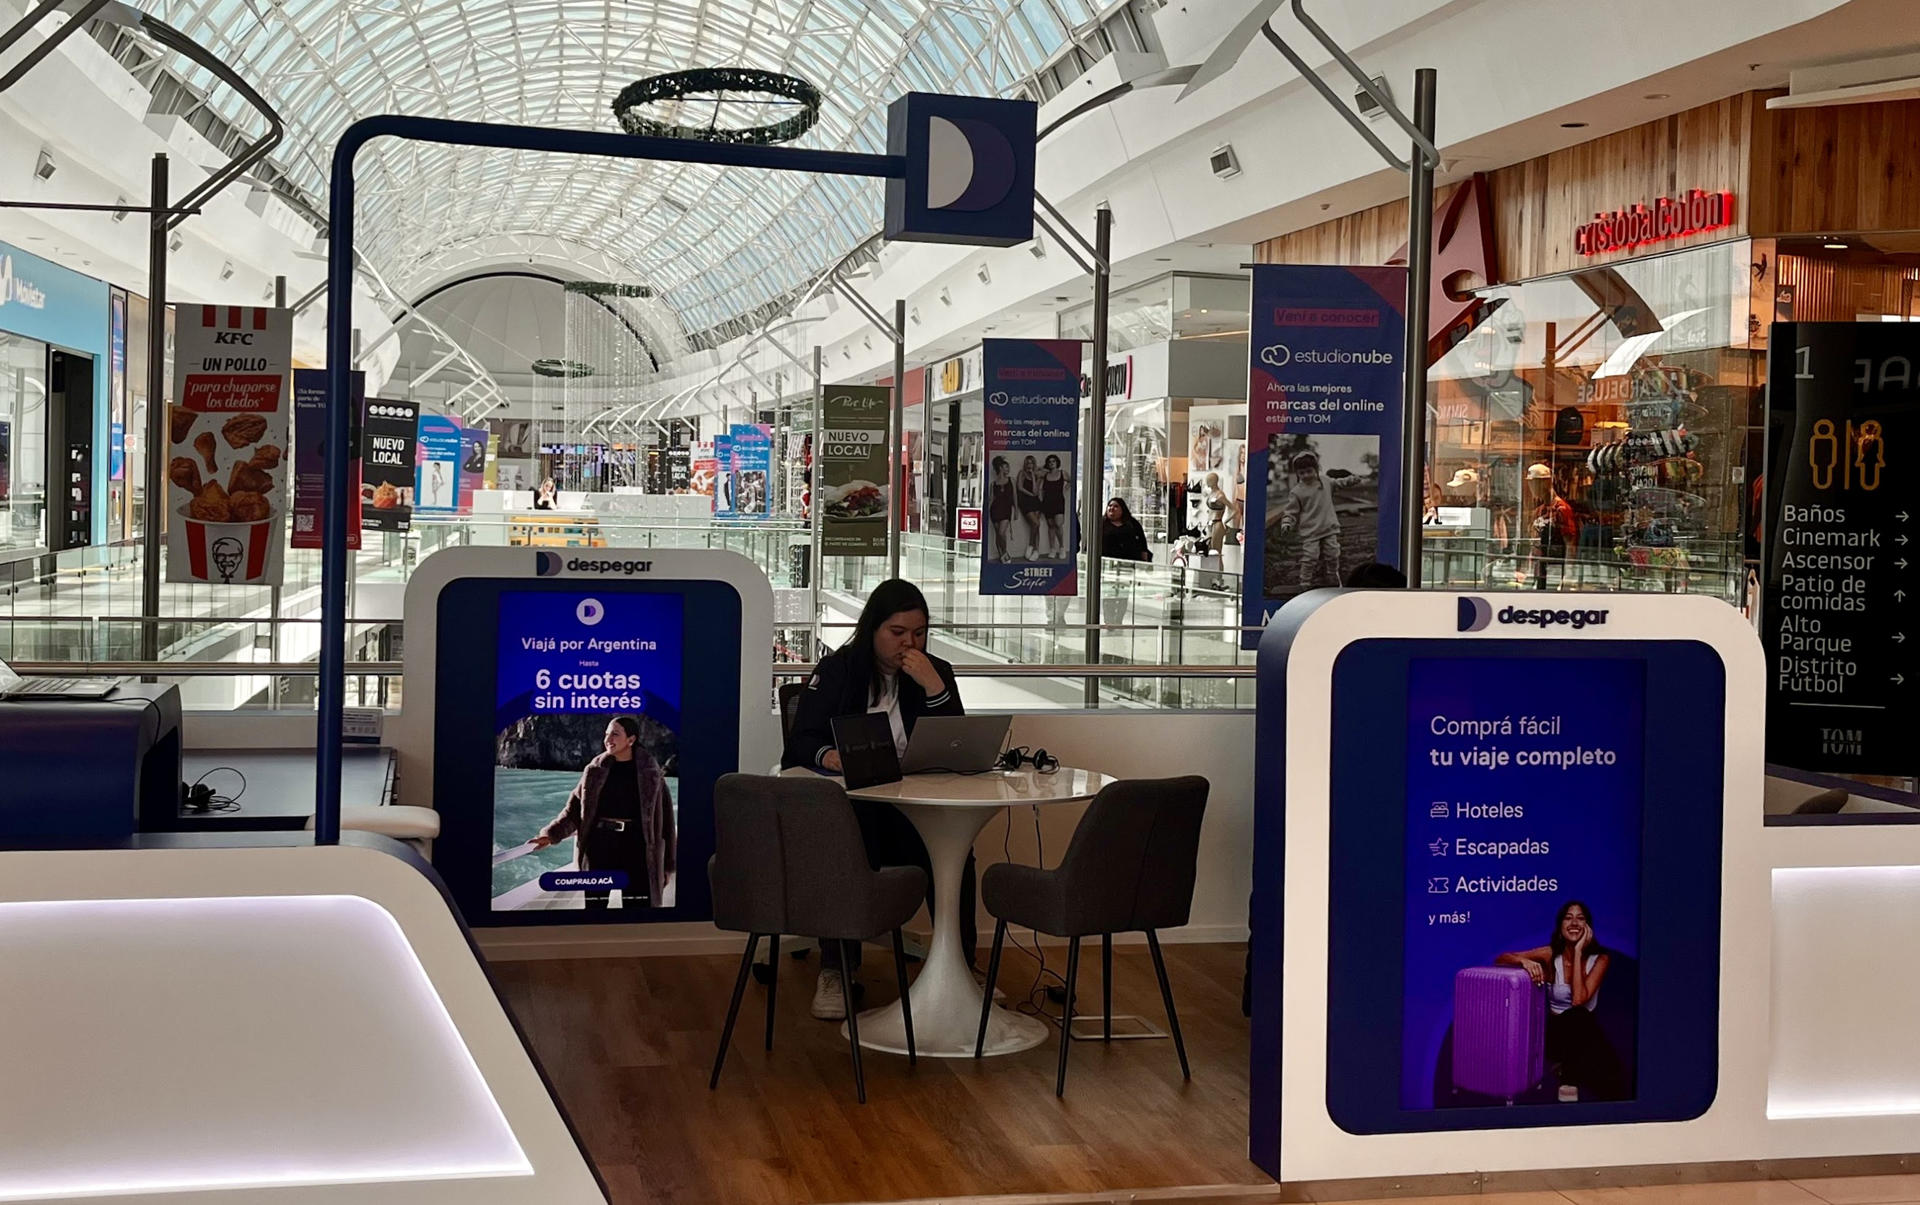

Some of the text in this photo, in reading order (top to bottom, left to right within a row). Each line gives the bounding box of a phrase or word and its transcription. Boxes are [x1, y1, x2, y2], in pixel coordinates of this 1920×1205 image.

[215, 332, 254, 346] KFC
[202, 357, 267, 374] UN POLLO
[1294, 349, 1393, 364] estudionube
[1794, 346, 1815, 379] 1
[222, 377, 277, 397] chuparse
[1265, 382, 1352, 396] Ahora las mejores
[206, 392, 221, 408] los
[1011, 394, 1075, 405] estudionube
[1266, 399, 1385, 412] marcas del online
[1265, 414, 1331, 424] están en TOM
[828, 431, 870, 442] NUEVO
[993, 428, 1071, 439] marcas del online
[372, 437, 405, 451] NUEVO
[828, 444, 869, 456] LOCAL
[372, 450, 403, 465] LOCAL
[1783, 504, 1846, 523] Baños
[1782, 528, 1881, 547] Cinemark
[566, 558, 653, 575] despegar
[1781, 552, 1875, 570] Ascensor
[1004, 571, 1047, 591] Style
[1024, 567, 1054, 577] STREET
[1781, 573, 1866, 594] Patio de
[1780, 592, 1866, 612] comidas
[1497, 605, 1609, 629] despegar
[1780, 615, 1822, 633] Alto
[521, 637, 658, 654] Viajá por Argentina
[1780, 633, 1852, 656] Parque
[578, 659, 600, 668] Hasta
[1779, 656, 1858, 676] Distrito
[535, 668, 642, 690] 6 cuotas
[1779, 672, 1844, 694] Fútbol
[534, 691, 642, 709] sin interés
[1430, 715, 1562, 740] Comprá fácil
[1429, 746, 1617, 770] tu viaje completo
[1456, 801, 1524, 819] Hoteles
[1455, 837, 1550, 859] Escapadas
[554, 877, 597, 886] COMPRALO
[1455, 874, 1559, 893] Actividades
[1428, 911, 1472, 926] y más!
